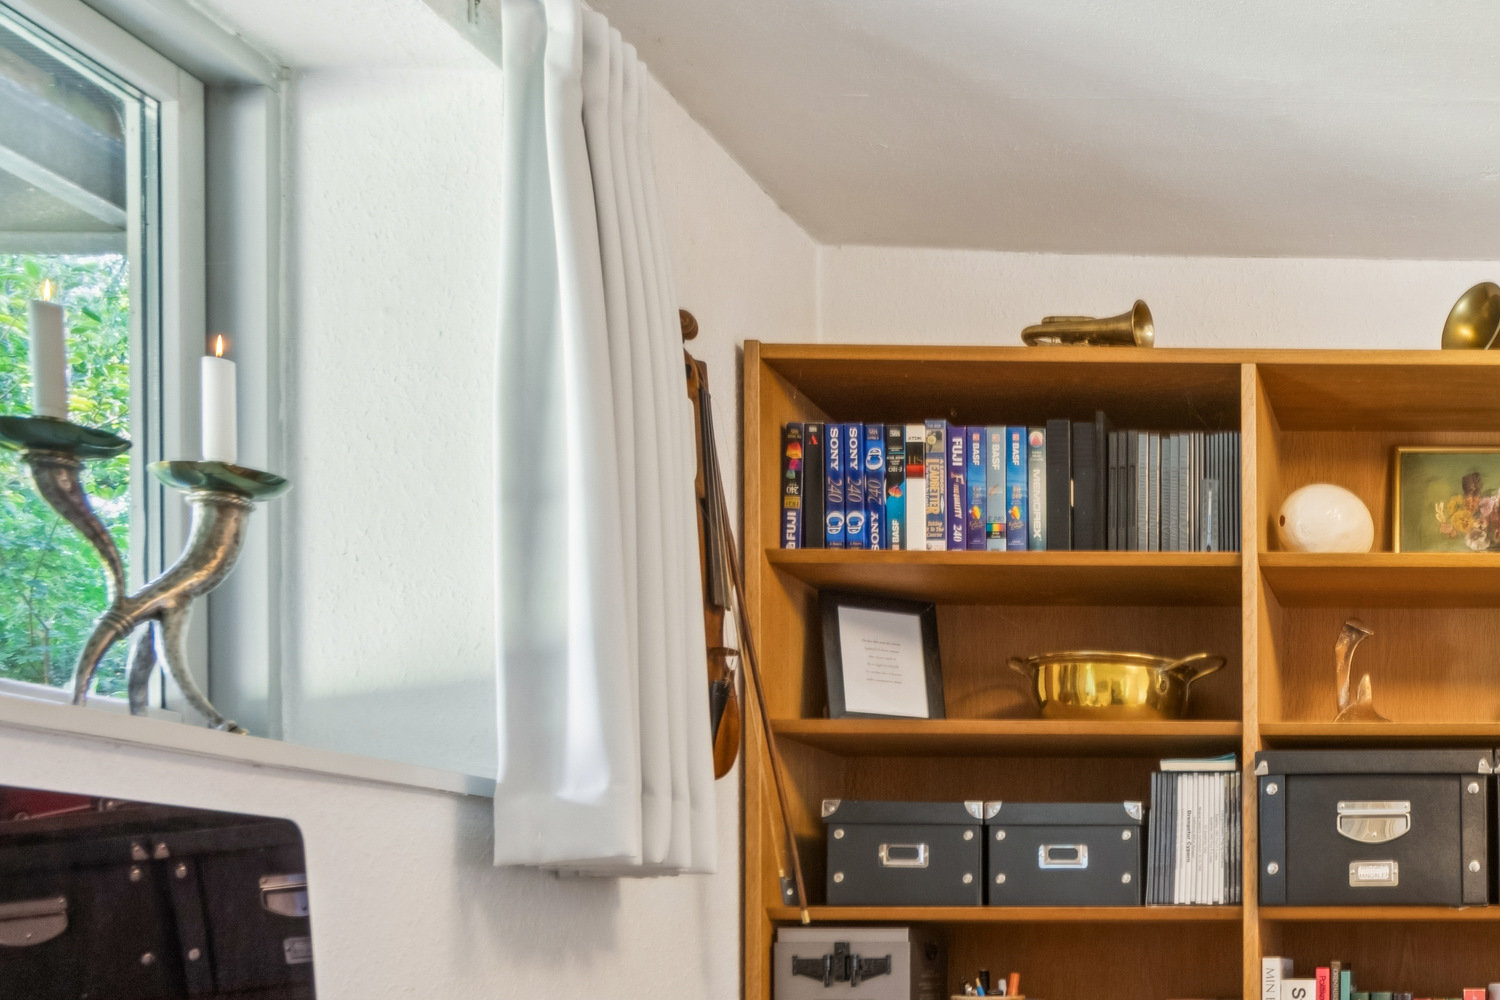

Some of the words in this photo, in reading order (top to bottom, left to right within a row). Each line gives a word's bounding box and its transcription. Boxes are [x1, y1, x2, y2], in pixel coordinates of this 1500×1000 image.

[829, 427, 839, 472] SONY
[849, 427, 859, 471] SONY
[952, 437, 964, 467] FUJI
[972, 442, 981, 466] BASF
[991, 443, 1001, 471] BASF
[1012, 442, 1021, 466] BASF
[827, 476, 843, 504] 240
[847, 476, 863, 504] 240
[866, 479, 883, 506] 240
[1032, 468, 1042, 538] MEMOREX
[786, 511, 797, 542] FUJI
[870, 512, 881, 550] SONY
[892, 519, 900, 543] BASF
[953, 523, 963, 543] 240
[1266, 967, 1277, 994] MIN
